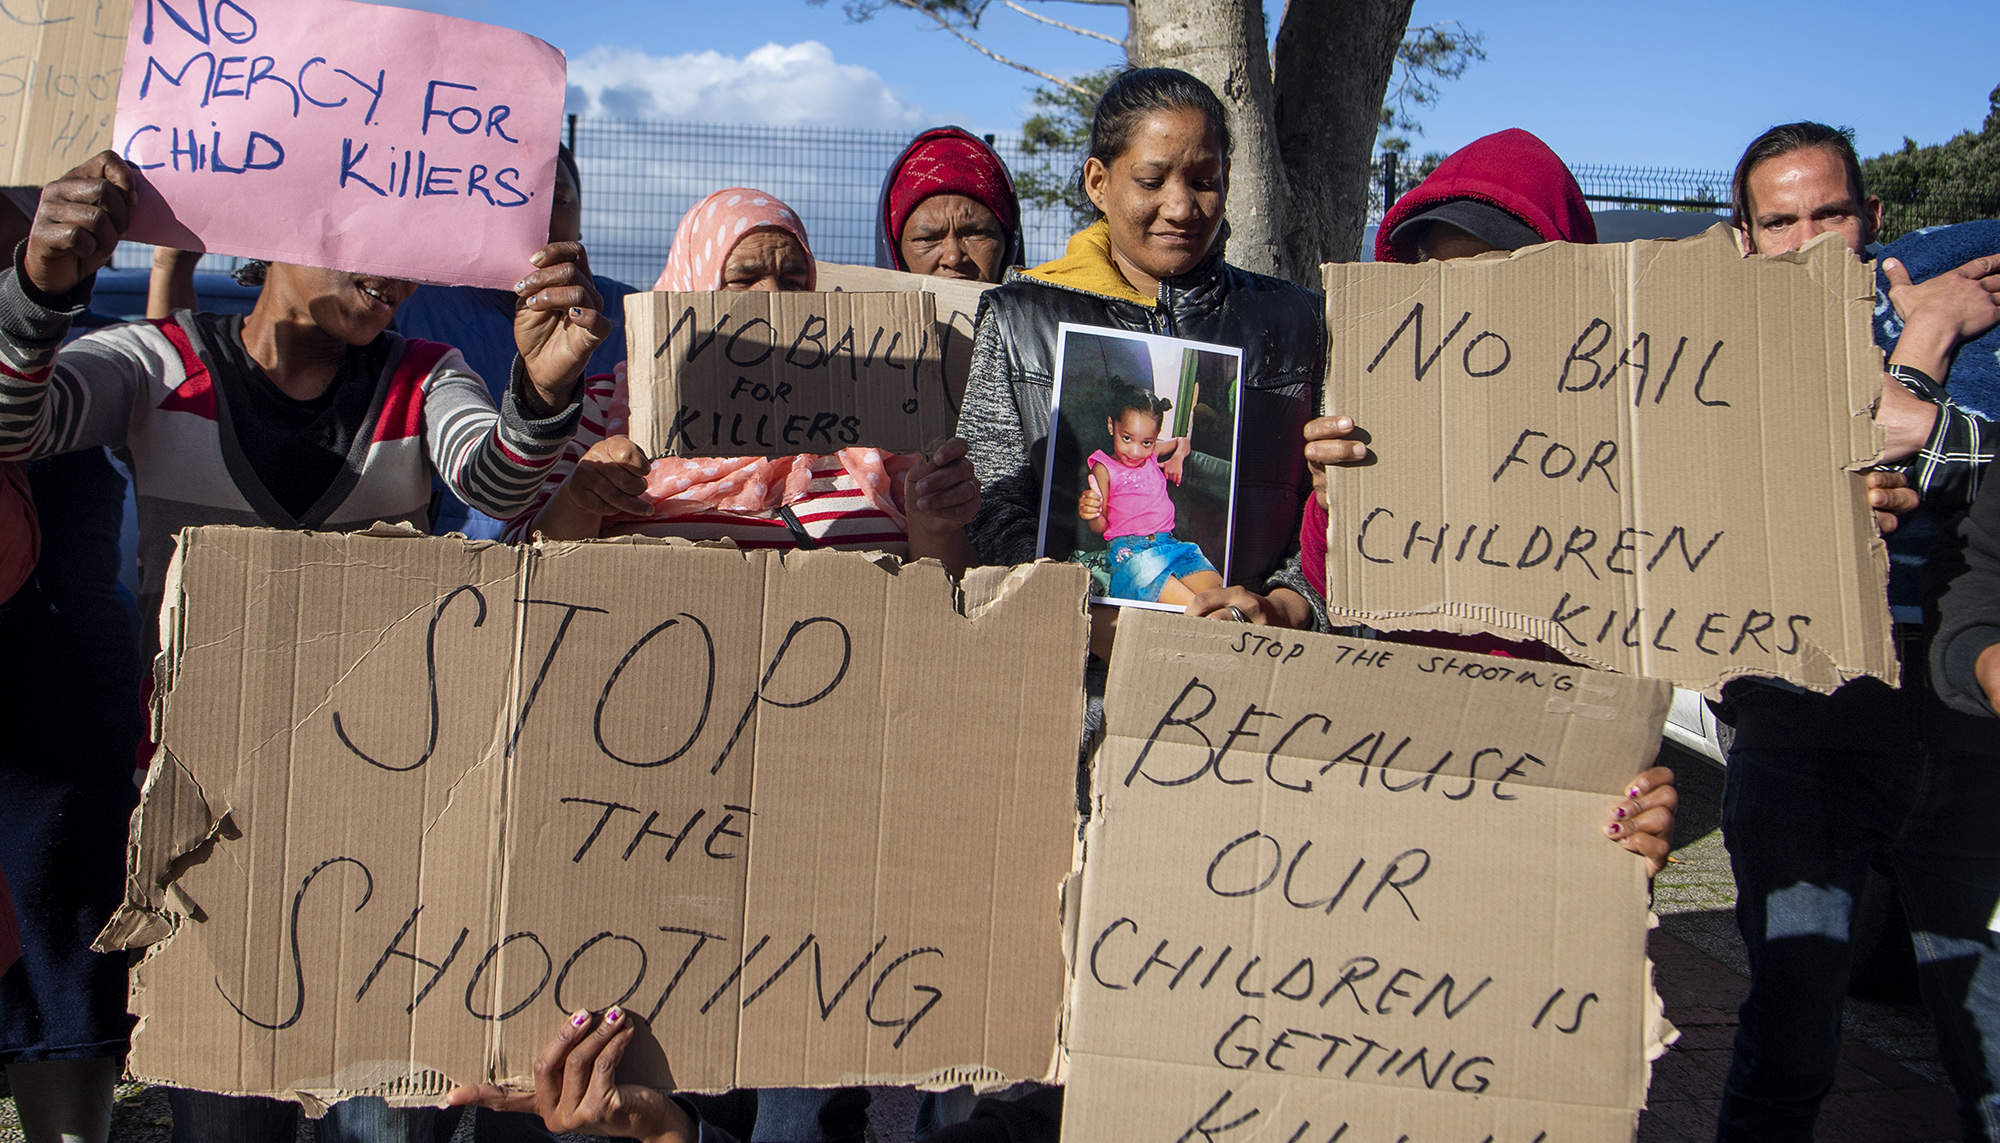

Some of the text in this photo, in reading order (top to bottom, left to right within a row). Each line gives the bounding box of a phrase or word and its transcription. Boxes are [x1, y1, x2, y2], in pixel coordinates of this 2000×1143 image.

[143, 0, 258, 46] NO
[421, 80, 519, 144] FOR
[654, 306, 778, 364] NO
[1367, 302, 1731, 408] NO BAIL
[730, 376, 793, 404] FOR
[665, 405, 861, 450] KILLERS
[1493, 428, 1619, 493] FOR
[1356, 507, 1725, 580] CHILDREN
[1551, 592, 1811, 656] KILLERS
[333, 583, 853, 776] STOP
[1230, 631, 1574, 692] STOP THE SHOOTING
[1123, 676, 1547, 801] BECAUSE
[560, 796, 757, 863] THE
[1205, 830, 1431, 922] OUR
[214, 856, 945, 1050] SHOOTING
[1089, 917, 1599, 1034] CHILDREN IS
[1213, 1013, 1496, 1095] GETTING
